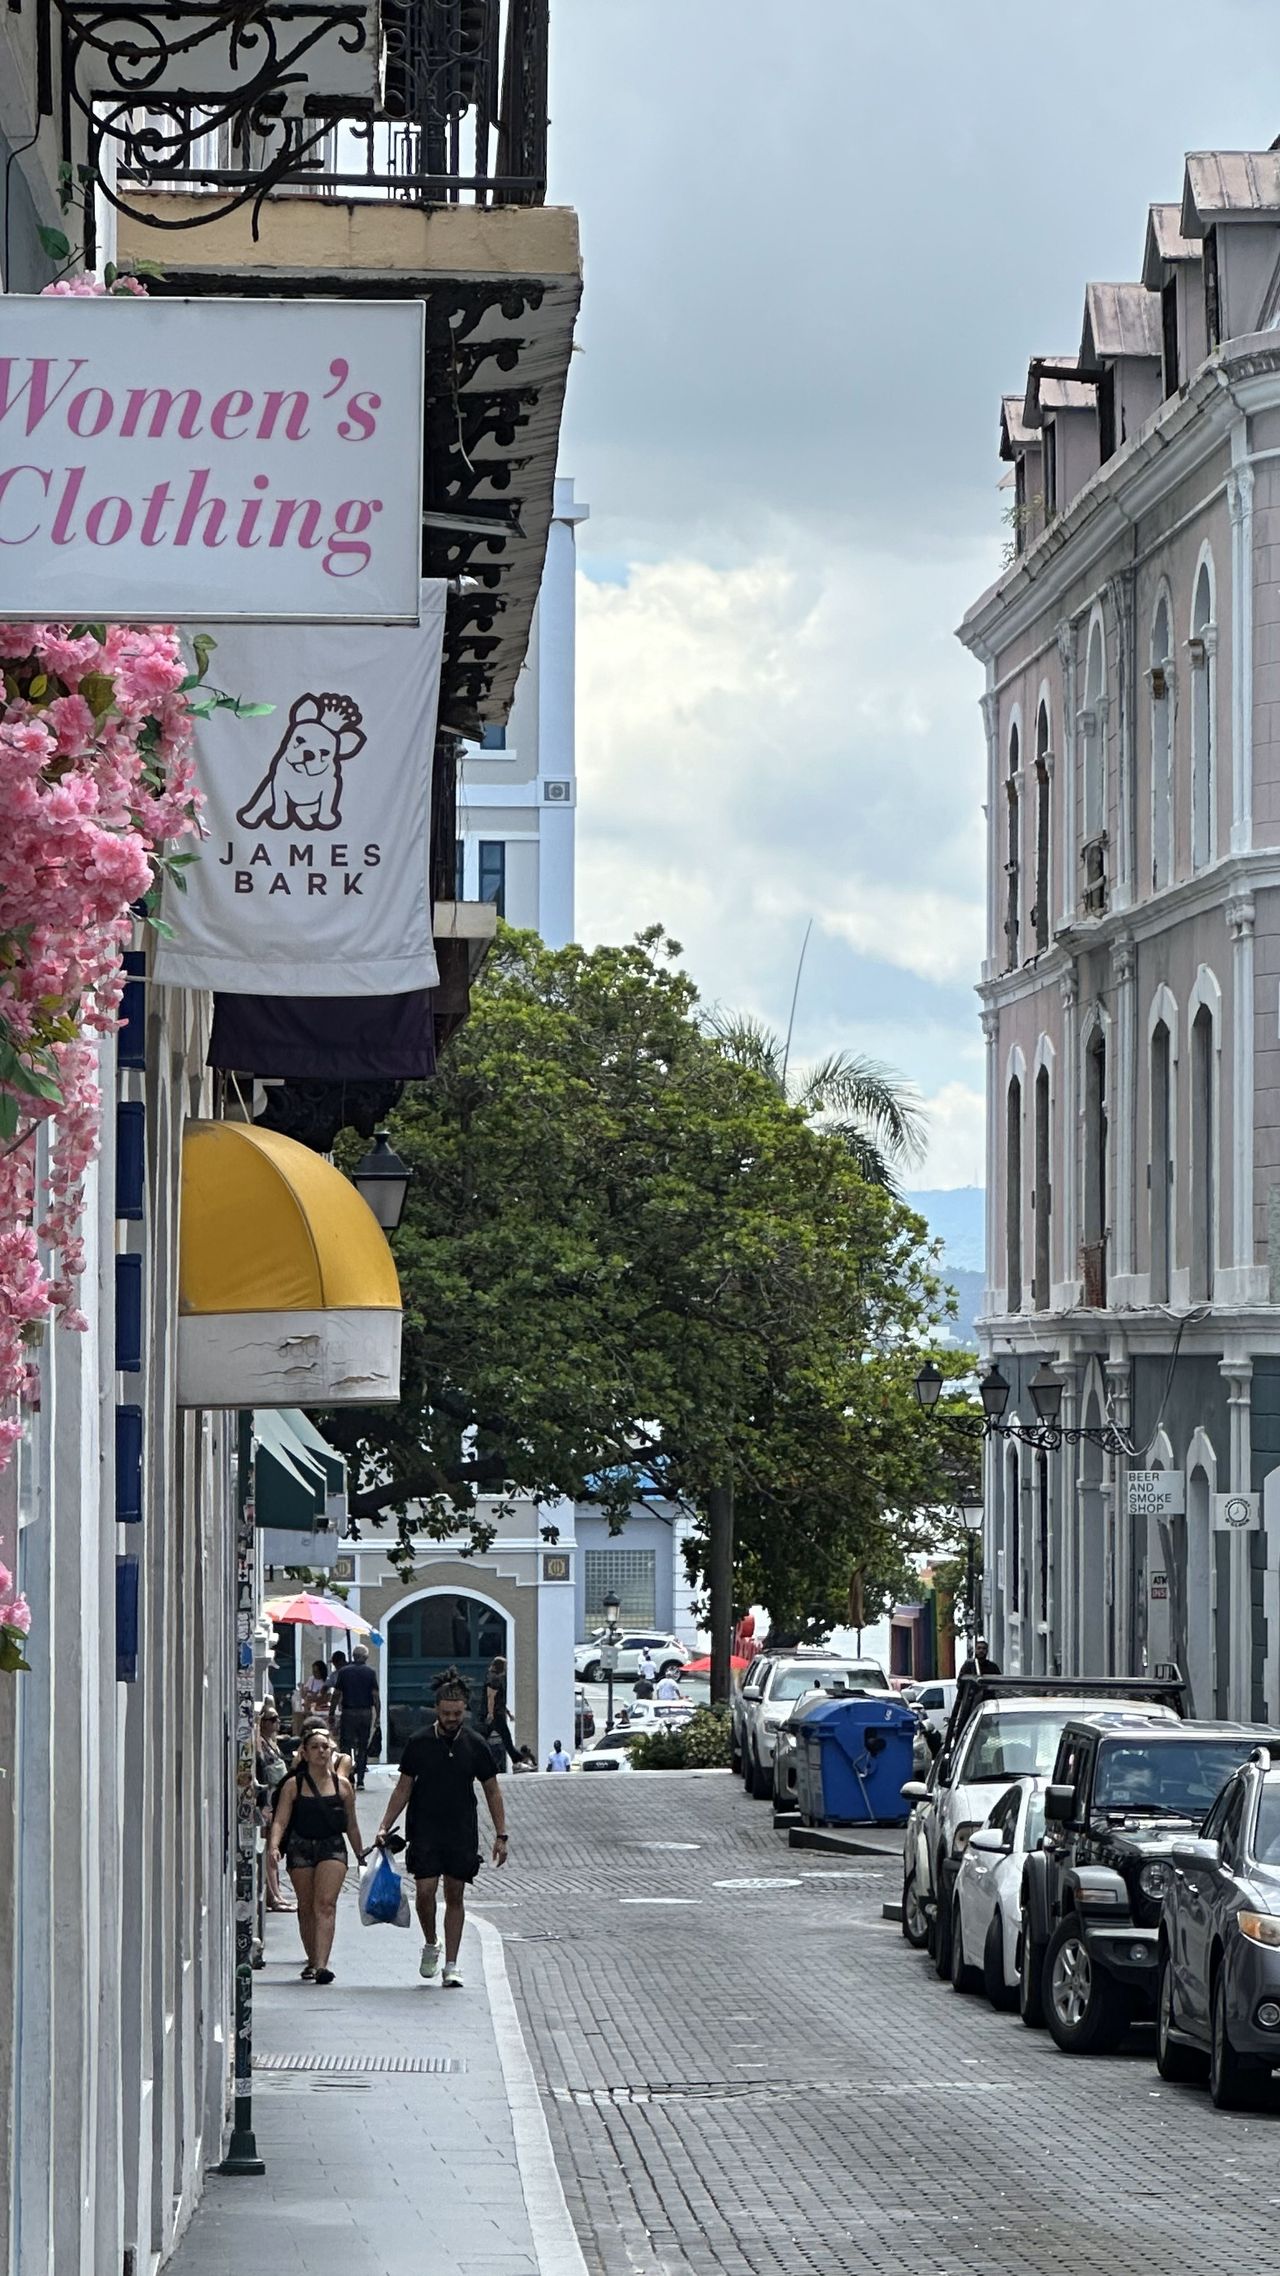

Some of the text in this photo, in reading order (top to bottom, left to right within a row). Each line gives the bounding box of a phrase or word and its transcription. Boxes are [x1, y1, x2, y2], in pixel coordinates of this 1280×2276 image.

[0, 358, 382, 442] Women's
[0, 465, 383, 578] Clothing
[219, 842, 381, 867] JAMES
[234, 871, 364, 895] BARK
[1129, 1472, 1160, 1481] BEER
[1129, 1482, 1154, 1492] AND
[1129, 1493, 1172, 1503] SMOKE
[1130, 1503, 1164, 1513] SHOP
